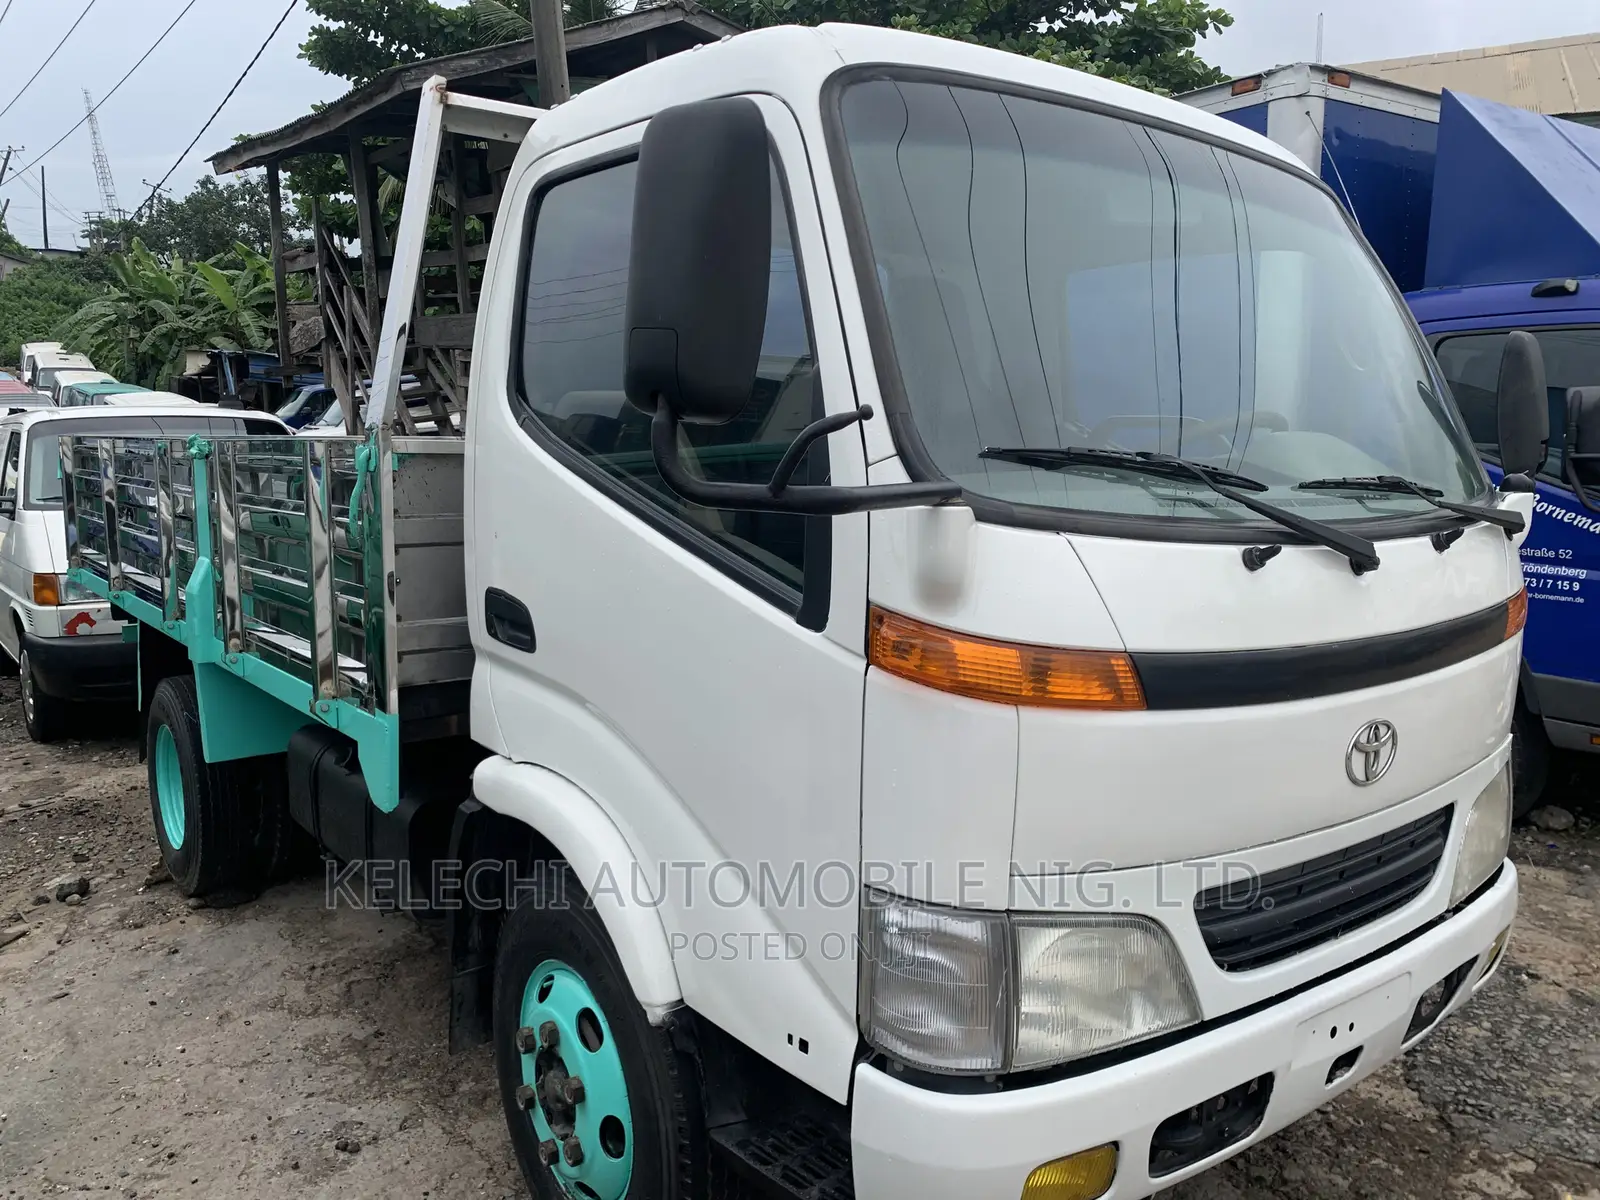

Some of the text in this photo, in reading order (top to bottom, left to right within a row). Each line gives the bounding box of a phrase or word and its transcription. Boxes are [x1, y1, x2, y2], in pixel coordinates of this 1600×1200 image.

[1558, 549, 1573, 559] 52
[1546, 579, 1553, 589] 7
[1556, 580, 1570, 590] 15
[1572, 581, 1580, 591] 9
